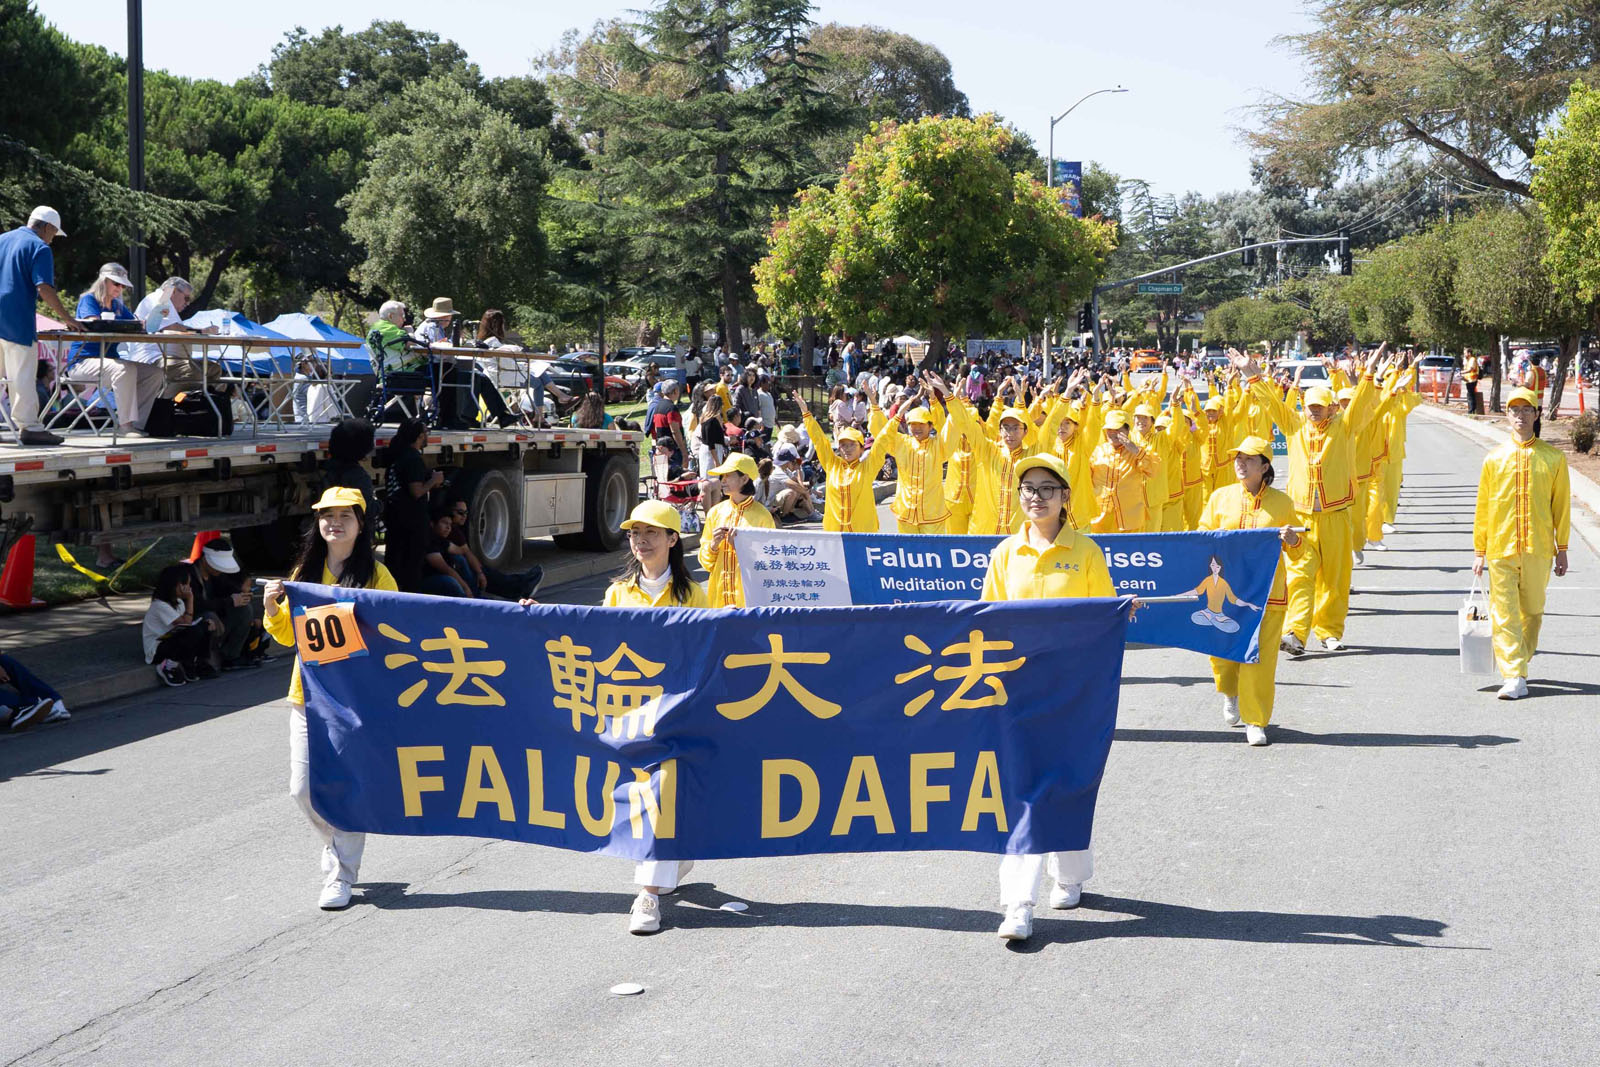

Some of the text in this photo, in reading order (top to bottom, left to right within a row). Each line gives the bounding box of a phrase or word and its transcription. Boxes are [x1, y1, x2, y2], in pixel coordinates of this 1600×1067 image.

[762, 544, 816, 556] 法輪功
[865, 546, 942, 569] Falun
[1104, 546, 1163, 568] ises
[753, 560, 831, 571] 義務教功班
[880, 576, 966, 592] Meditation
[770, 592, 820, 603] 身心健康
[304, 613, 347, 653] 90
[377, 621, 1027, 740] 法輪大法
[396, 745, 1009, 840] FALUN DAFA
